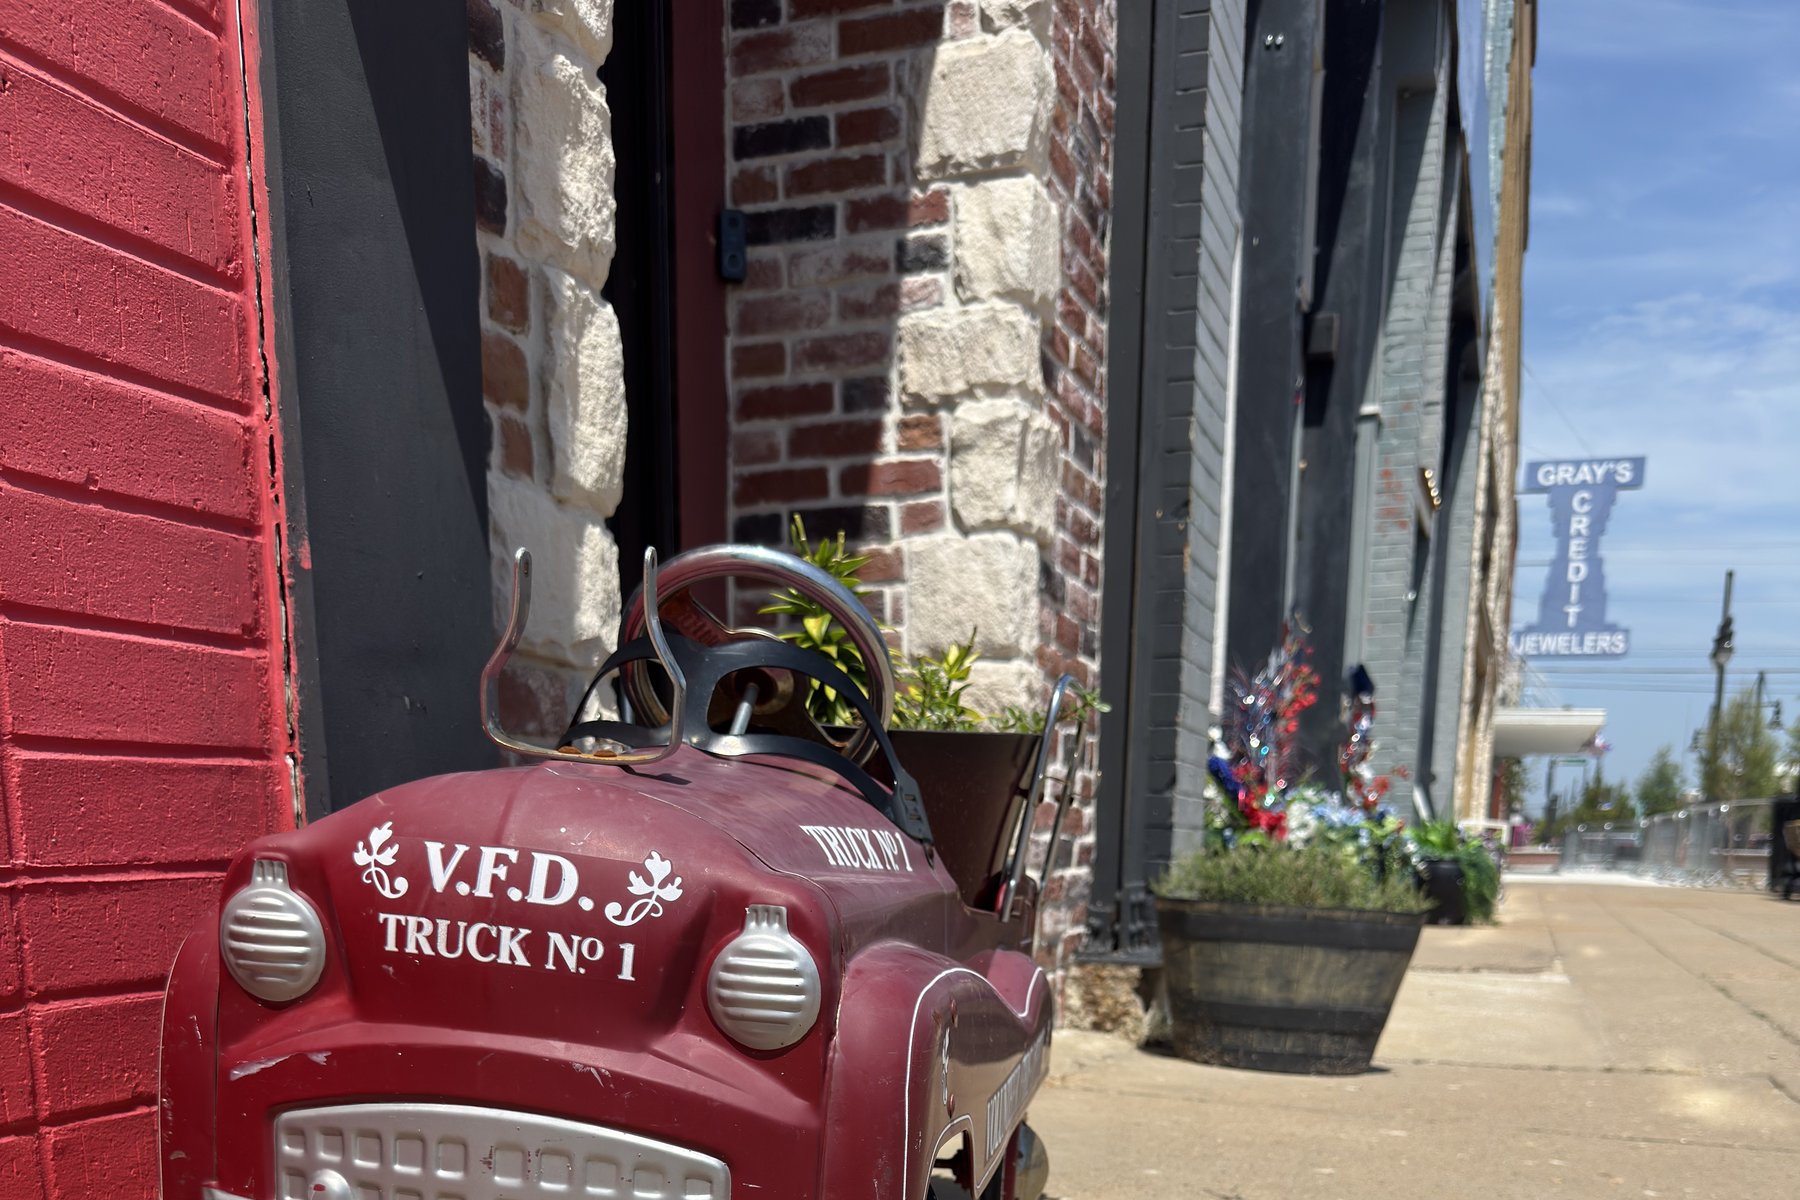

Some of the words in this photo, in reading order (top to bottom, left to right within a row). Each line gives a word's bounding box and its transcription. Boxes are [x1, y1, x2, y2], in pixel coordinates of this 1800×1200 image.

[1537, 461, 1634, 486] GRAY'S
[1563, 490, 1593, 628] CREDIT
[1511, 631, 1627, 655] JEWELERS
[424, 841, 595, 911] V.F.D.
[799, 825, 884, 869] TRUCK
[894, 832, 913, 872] 1
[378, 912, 532, 968] TRUCK
[617, 943, 635, 981] 1
